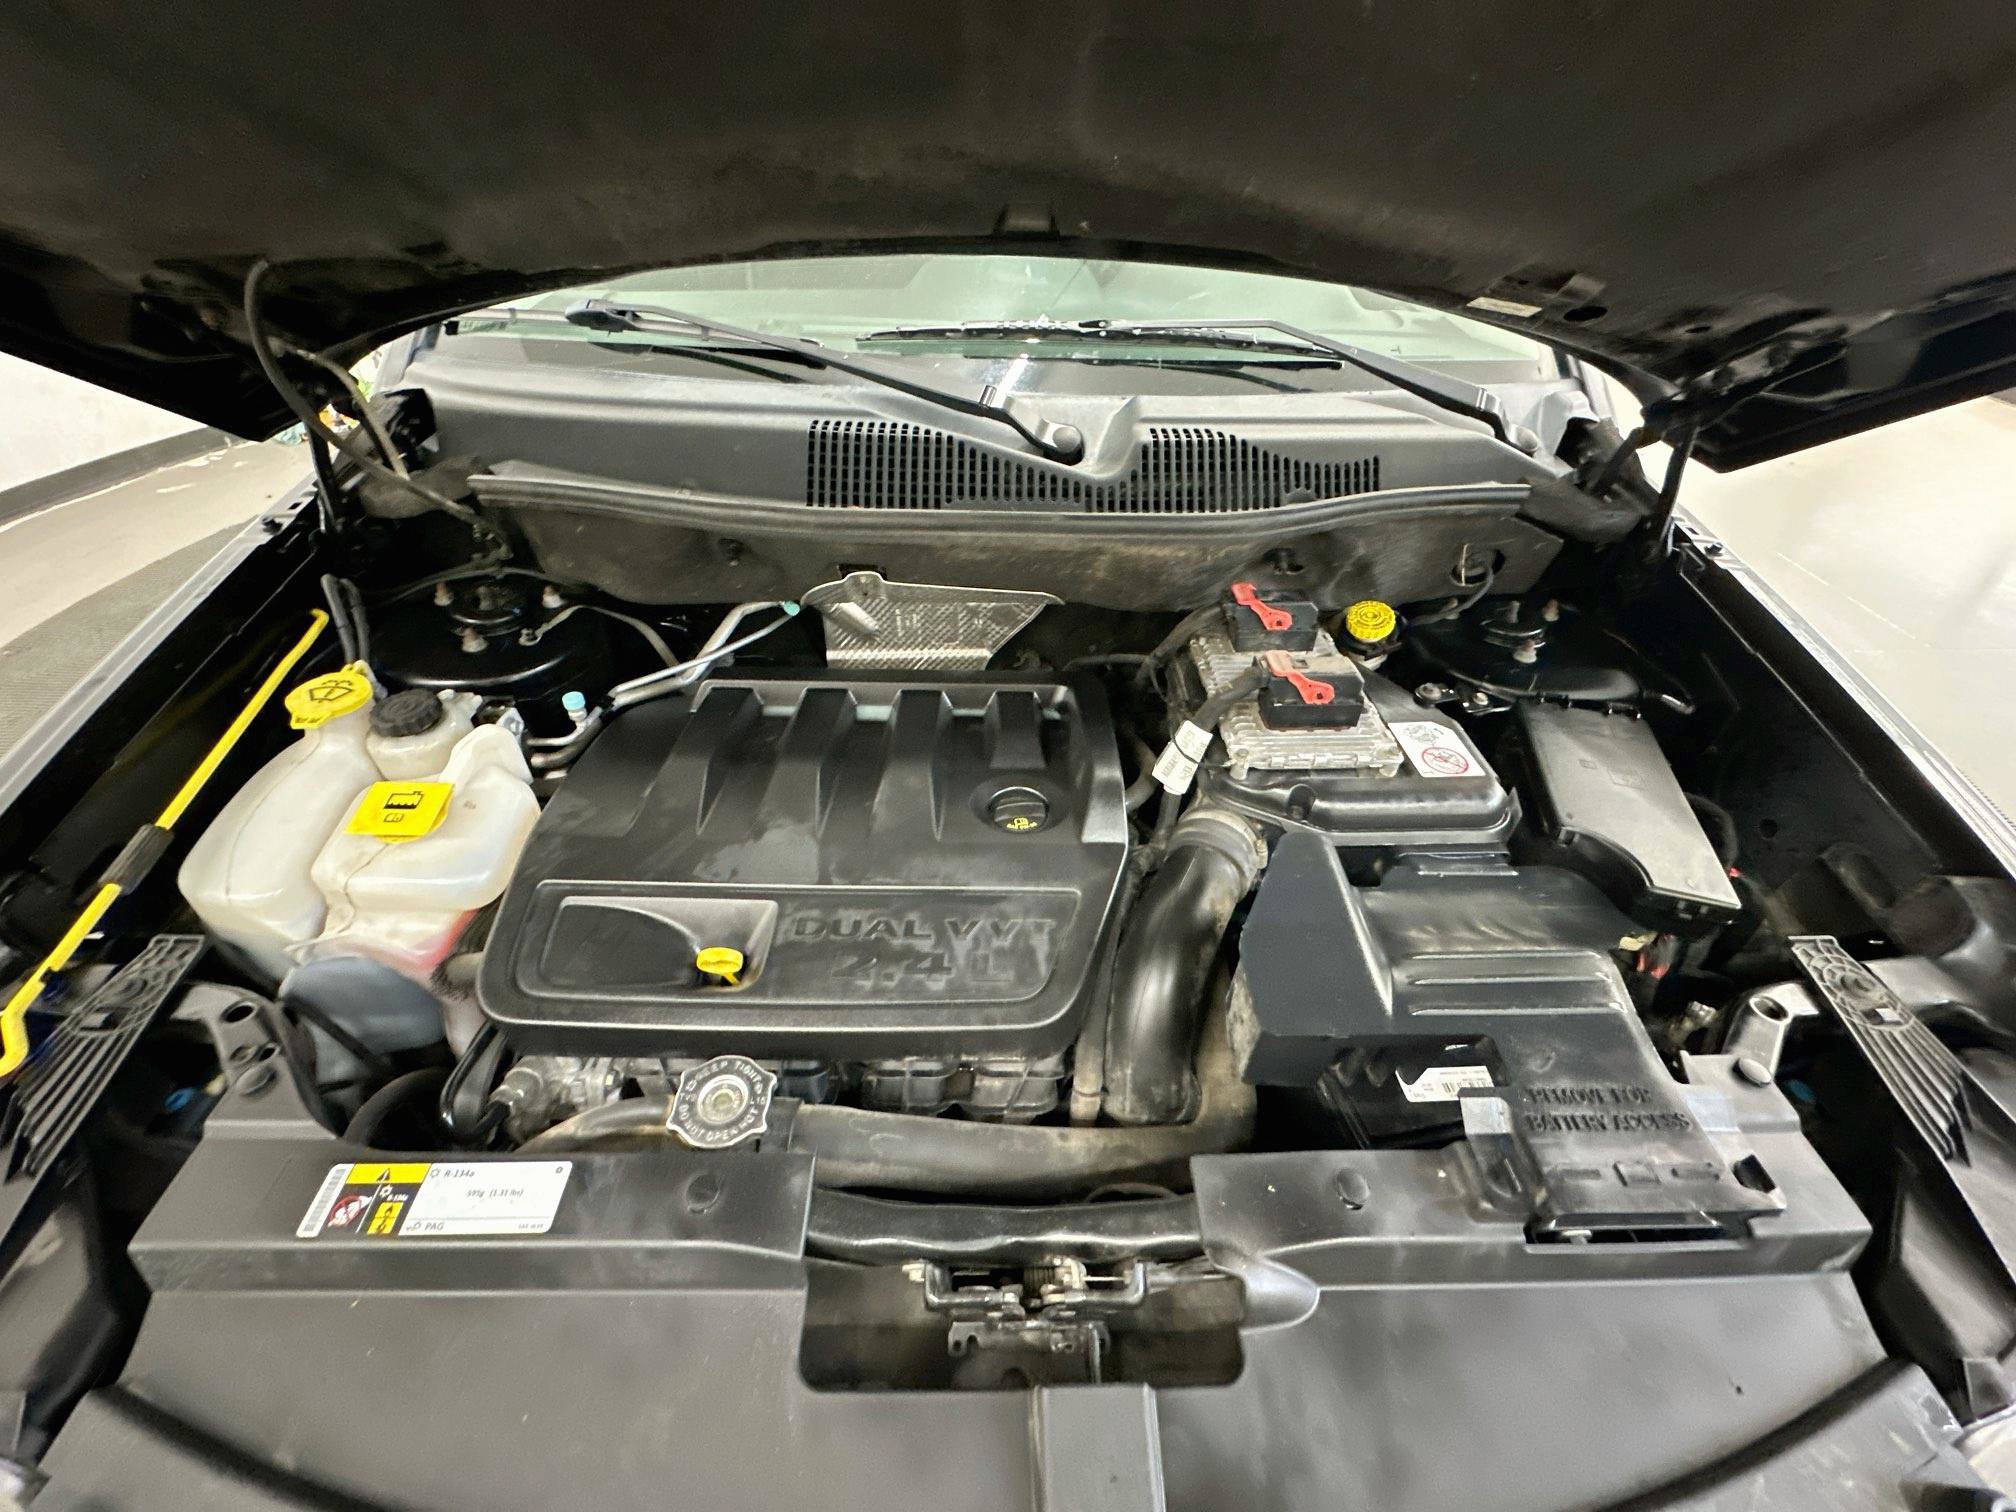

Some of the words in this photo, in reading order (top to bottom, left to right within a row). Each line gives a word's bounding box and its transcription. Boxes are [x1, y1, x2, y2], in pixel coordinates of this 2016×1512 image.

[793, 917, 935, 941] DUAL
[946, 917, 1056, 946] VVT
[424, 1222, 444, 1231] PAG
